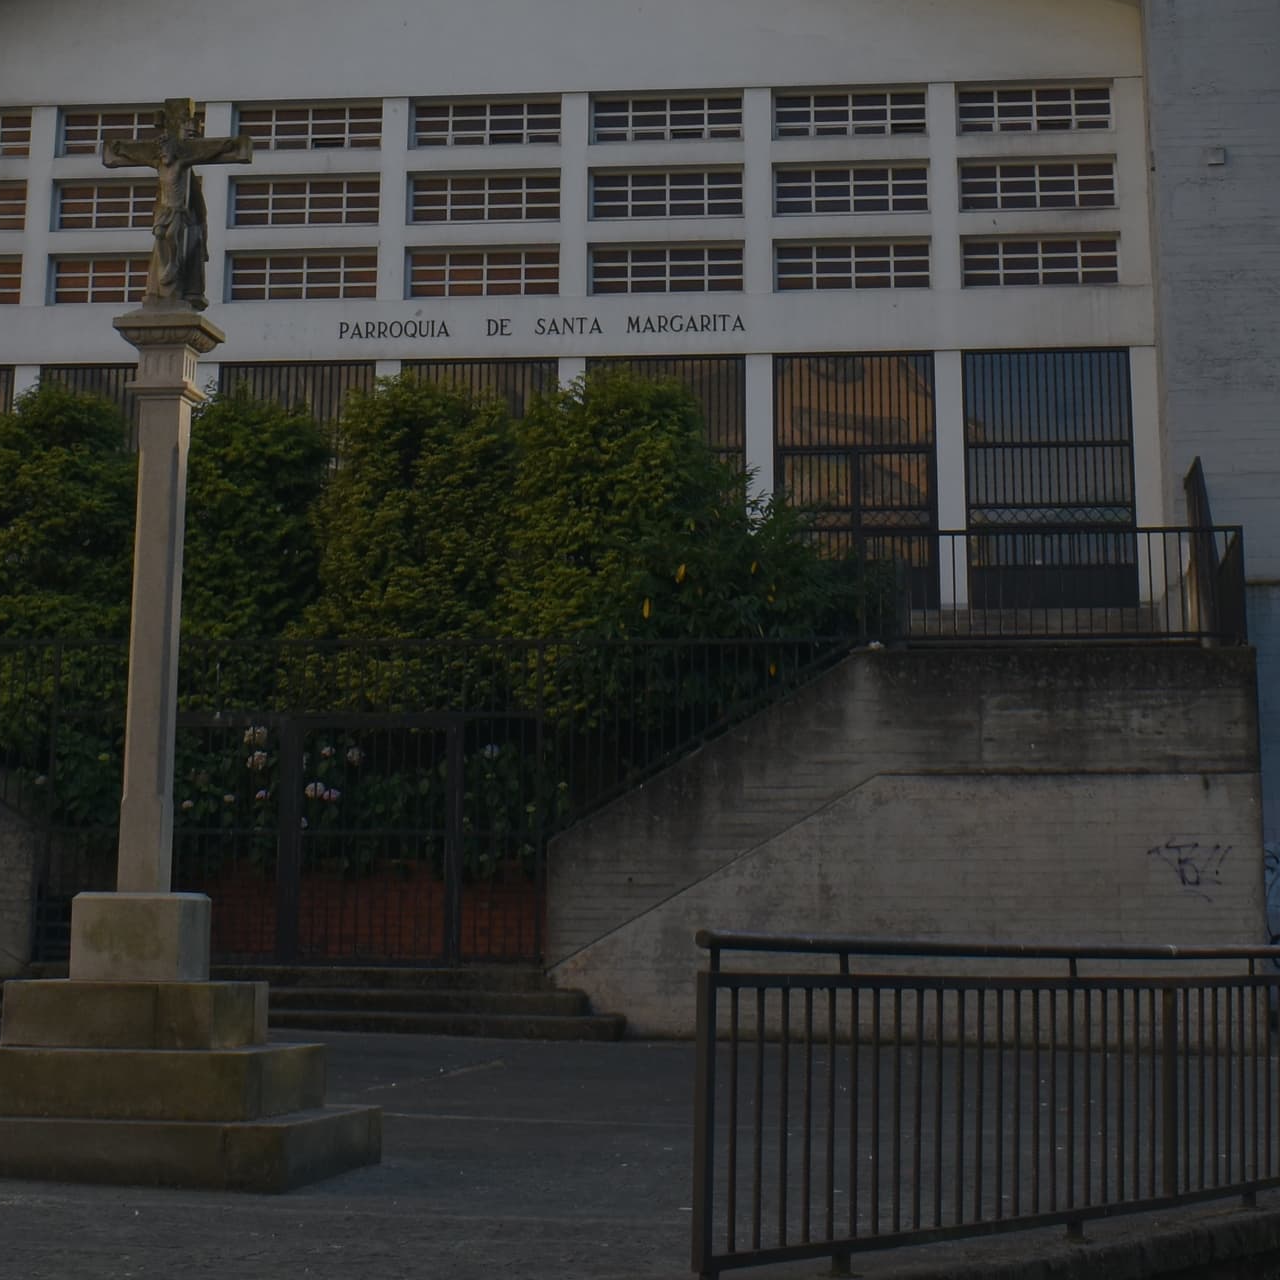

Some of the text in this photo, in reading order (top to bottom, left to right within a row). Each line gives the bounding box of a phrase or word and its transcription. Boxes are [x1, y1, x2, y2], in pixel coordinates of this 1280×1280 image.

[338, 313, 746, 340] PARROQUIA DE SANTA MARGARITA
